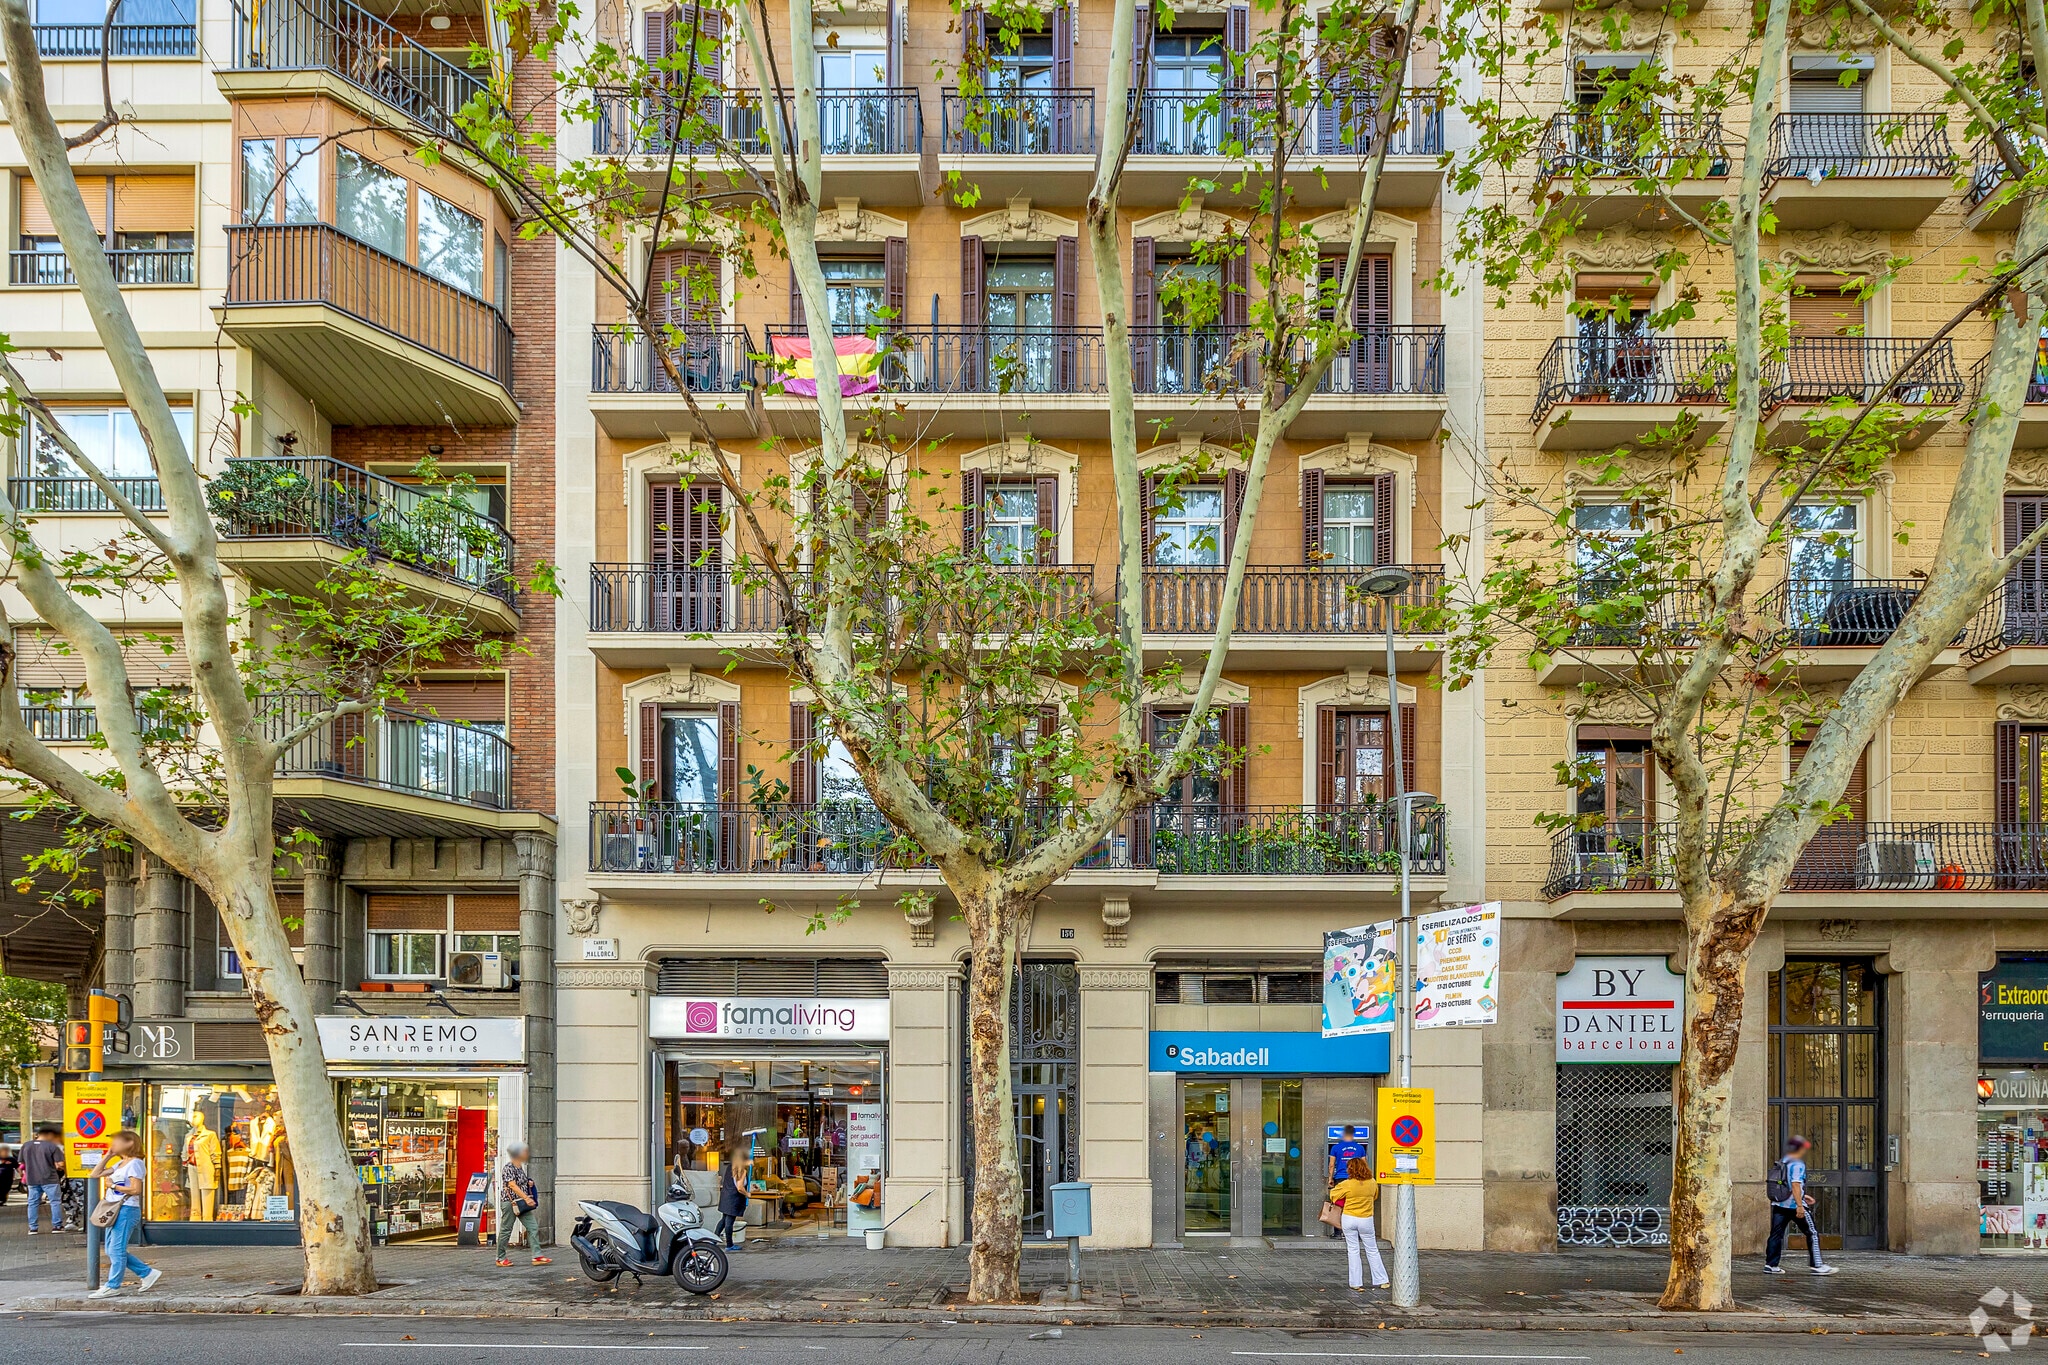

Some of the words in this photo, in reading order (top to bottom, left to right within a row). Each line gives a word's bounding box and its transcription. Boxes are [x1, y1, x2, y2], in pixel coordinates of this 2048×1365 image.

[1061, 929, 1074, 938] 156
[1448, 980, 1471, 988] OCTUBRE
[1592, 969, 1645, 996] BY
[1448, 999, 1471, 1007] OCTUBRE
[722, 1003, 855, 1031] famaliving
[1563, 1015, 1675, 1033] DANIEL
[724, 1026, 822, 1035] Barcelona
[1563, 1037, 1675, 1050] barcelona
[1180, 1047, 1269, 1066] Sabadell
[388, 1126, 411, 1135] SAN
[414, 1126, 443, 1135] REMO
